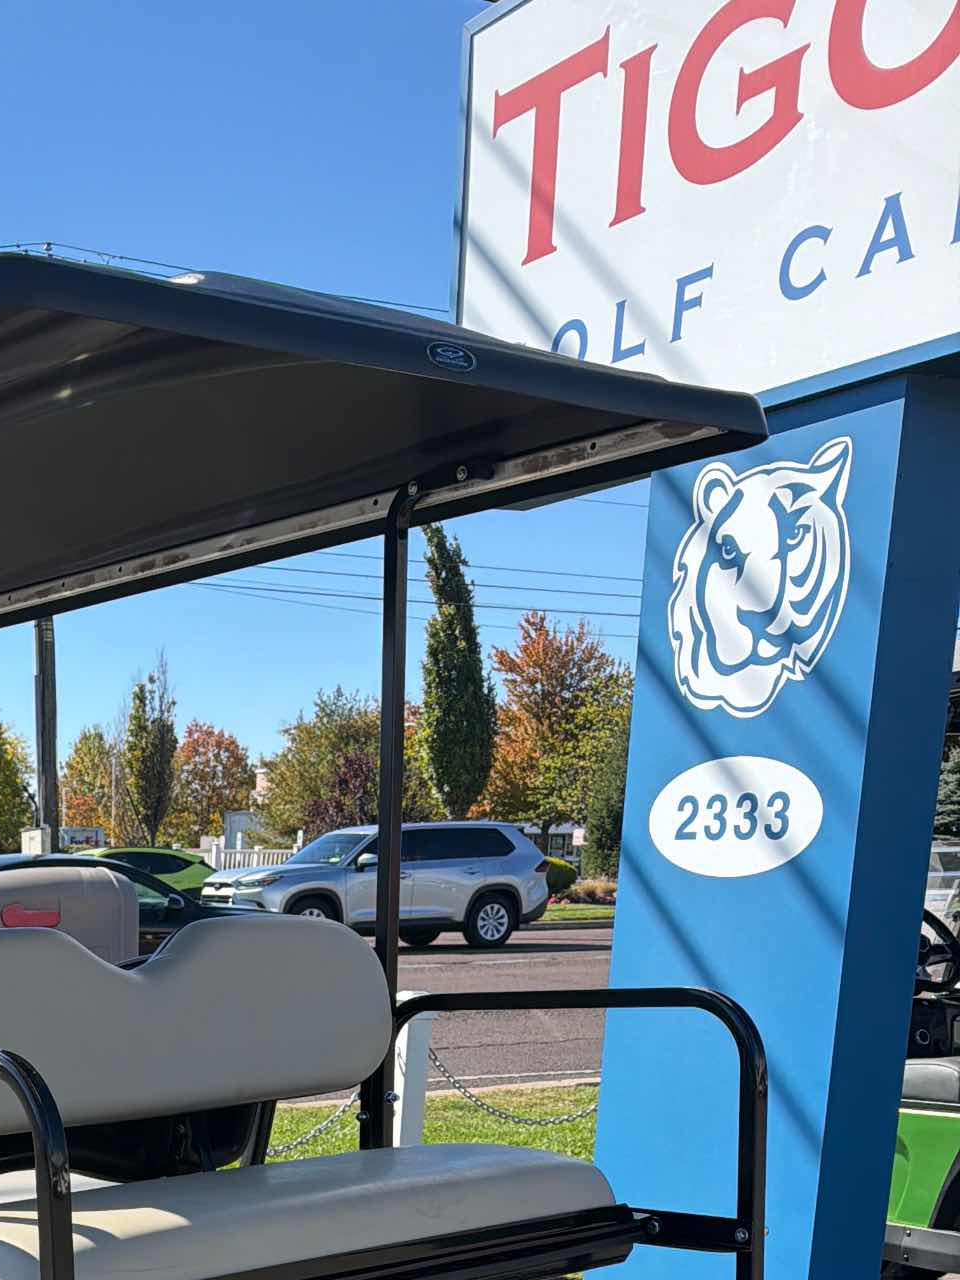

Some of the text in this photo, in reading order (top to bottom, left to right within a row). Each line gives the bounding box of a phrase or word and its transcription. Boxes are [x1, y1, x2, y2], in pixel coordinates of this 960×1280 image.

[514, 185, 960, 364] OLF CA
[674, 790, 791, 841] 2333
